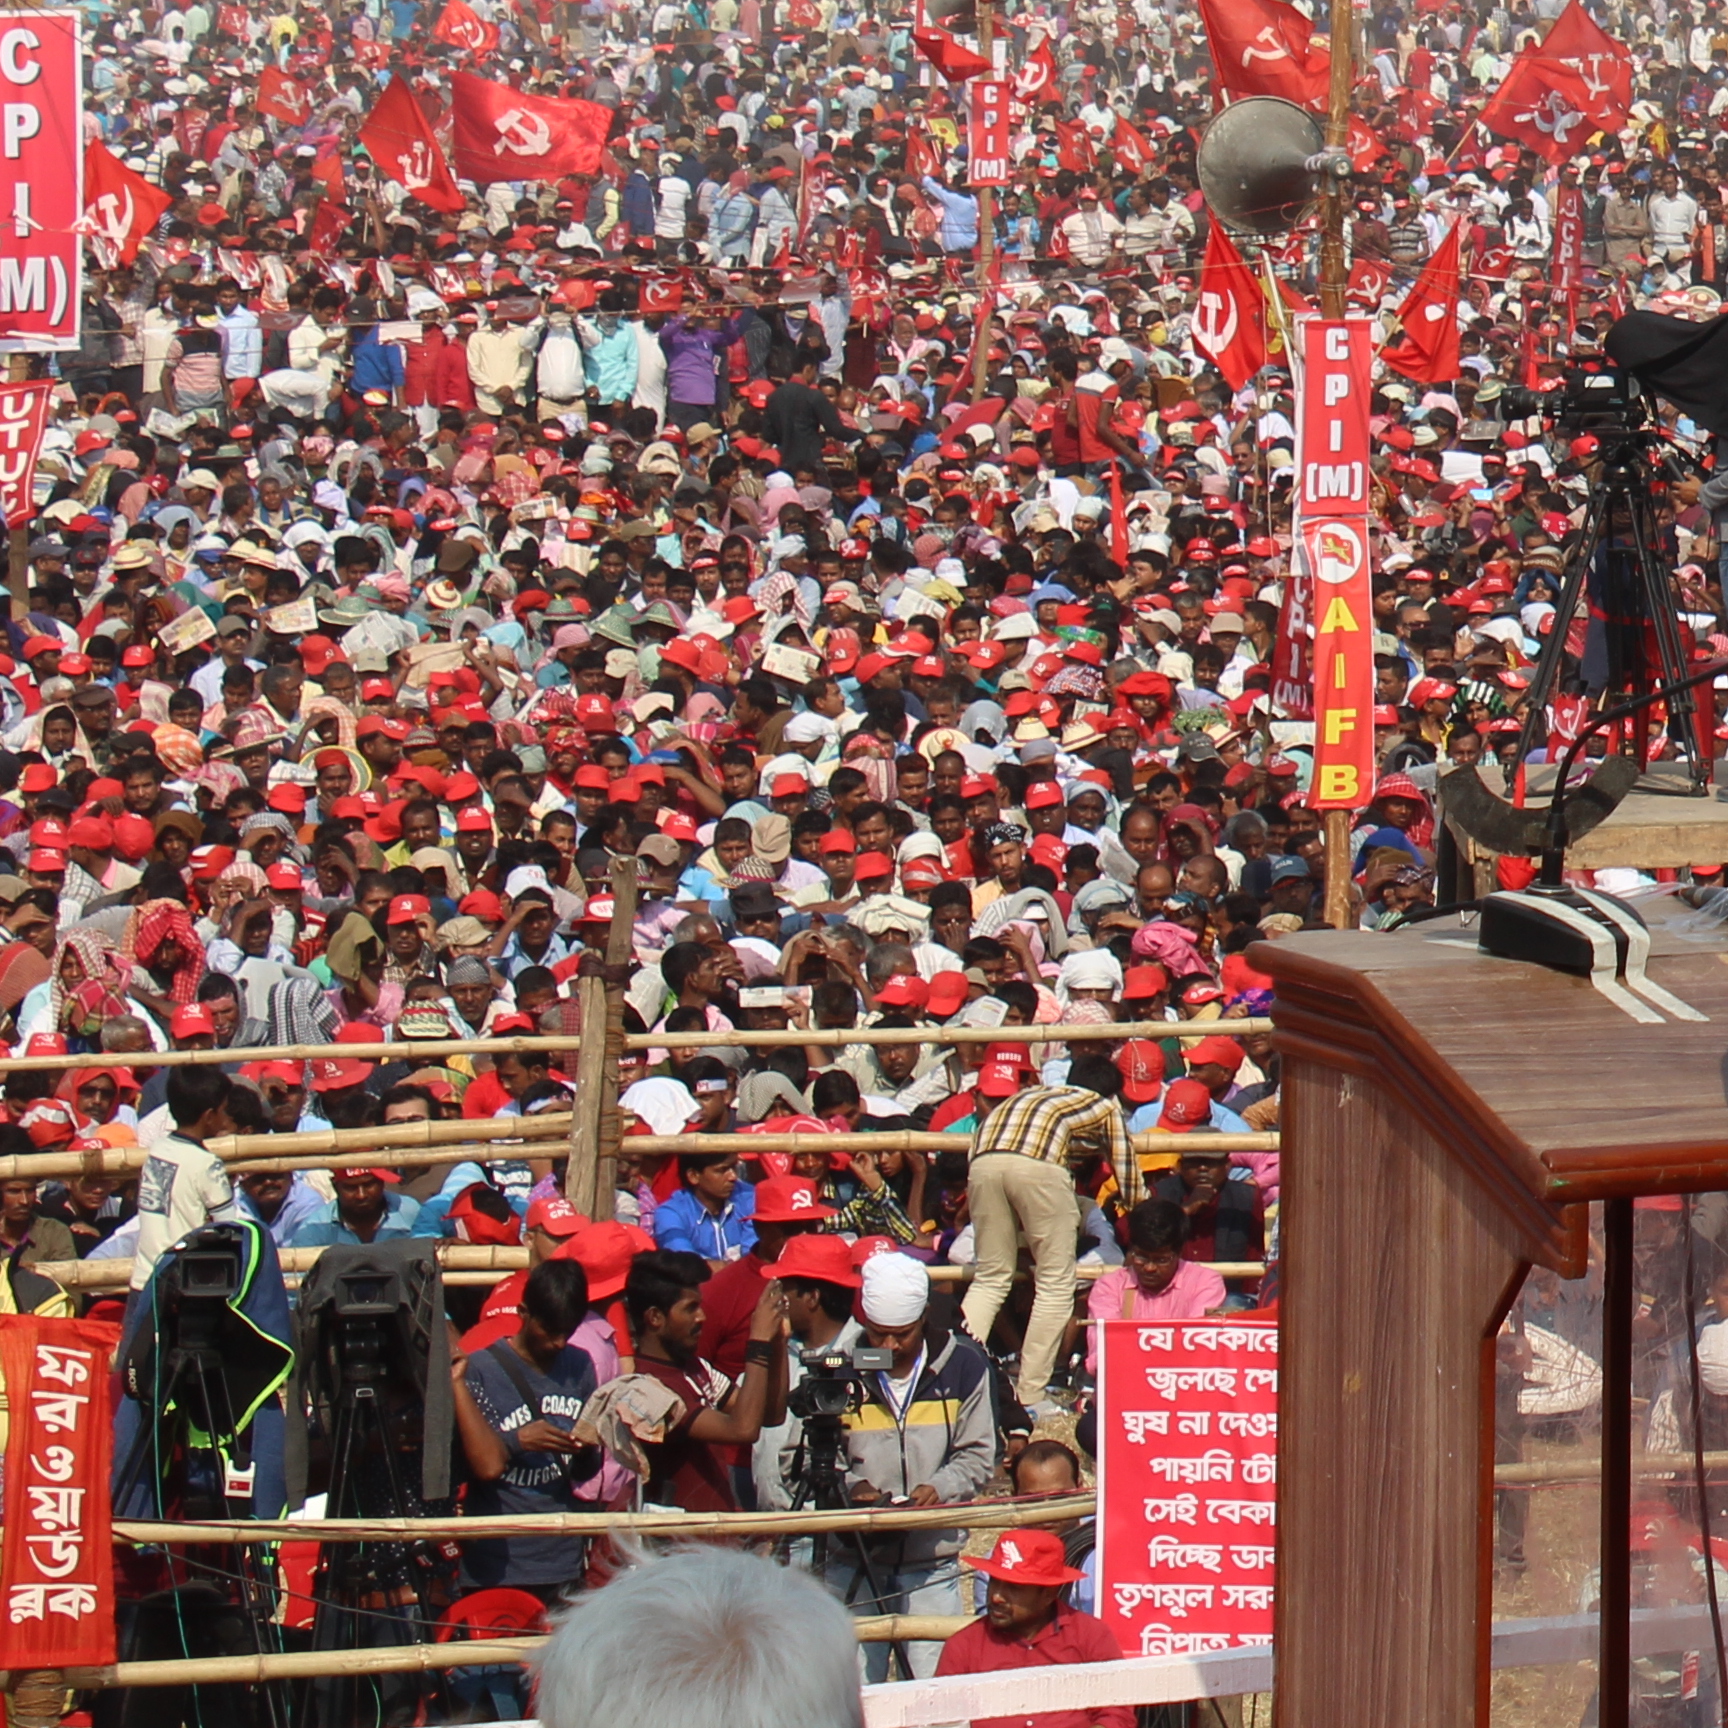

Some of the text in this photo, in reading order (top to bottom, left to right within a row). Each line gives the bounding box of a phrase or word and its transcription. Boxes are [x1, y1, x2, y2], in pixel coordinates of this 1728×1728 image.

[1305, 325, 1363, 503] CPI(M)
[1319, 604, 1360, 801] AIFB
[1137, 1327, 1175, 1352] যে
[500, 1394, 582, 1432] WES COAST
[1121, 1411, 1170, 1445] ঘুষ
[1177, 1411, 1211, 1436] না
[1143, 1493, 1199, 1526] সেই
[1113, 1582, 1215, 1619] তৃণমূল
